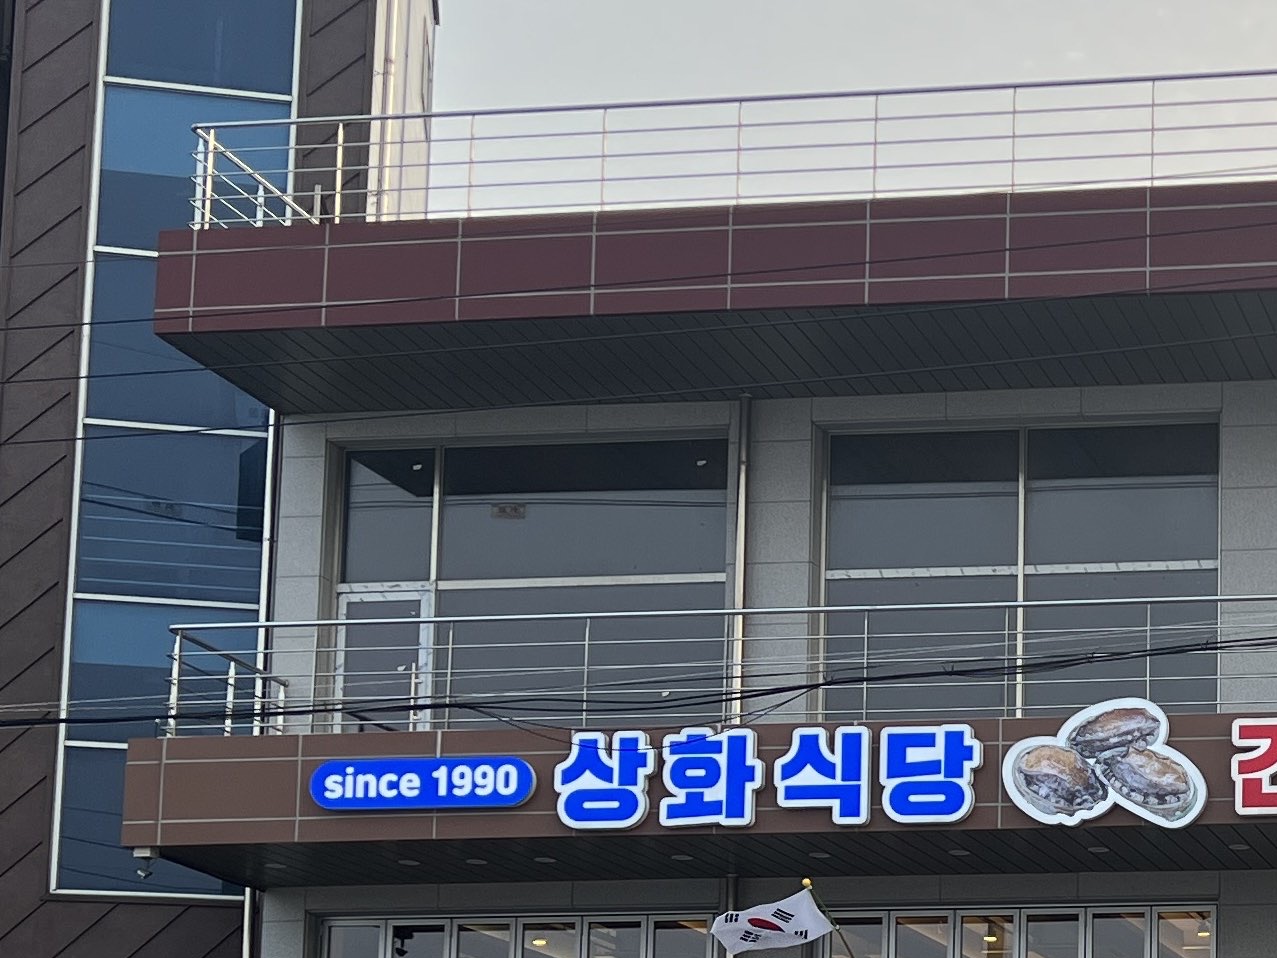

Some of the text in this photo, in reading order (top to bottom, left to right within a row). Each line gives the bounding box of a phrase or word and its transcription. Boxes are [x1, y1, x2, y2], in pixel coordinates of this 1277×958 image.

[324, 764, 518, 799] since 1990
[556, 726, 980, 829] 상화식당
